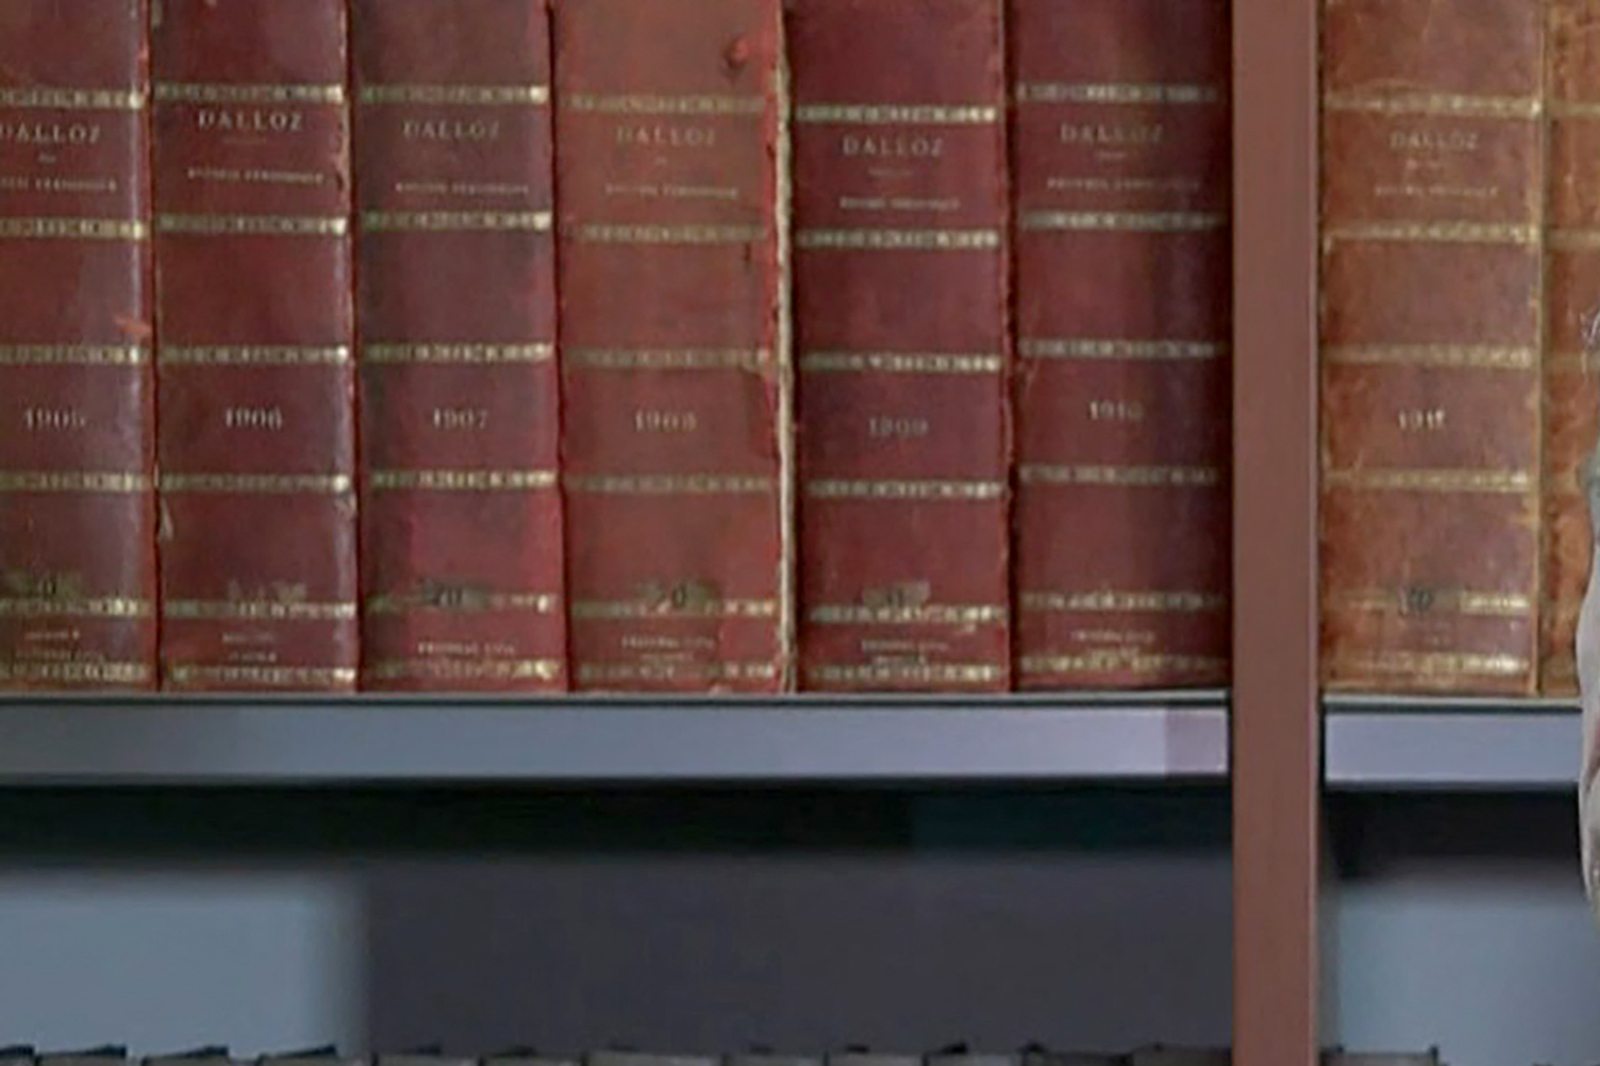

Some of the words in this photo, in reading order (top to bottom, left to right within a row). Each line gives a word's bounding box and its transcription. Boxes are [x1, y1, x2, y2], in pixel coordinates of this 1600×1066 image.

[199, 109, 304, 132] DALLOZ
[402, 119, 501, 140] DALLOZ
[615, 125, 716, 146] DALLOZ
[1061, 123, 1165, 144] DALLOZ
[1390, 131, 1480, 151] DALLOZ
[843, 134, 944, 157] DALLOZ
[432, 406, 489, 431] 1907
